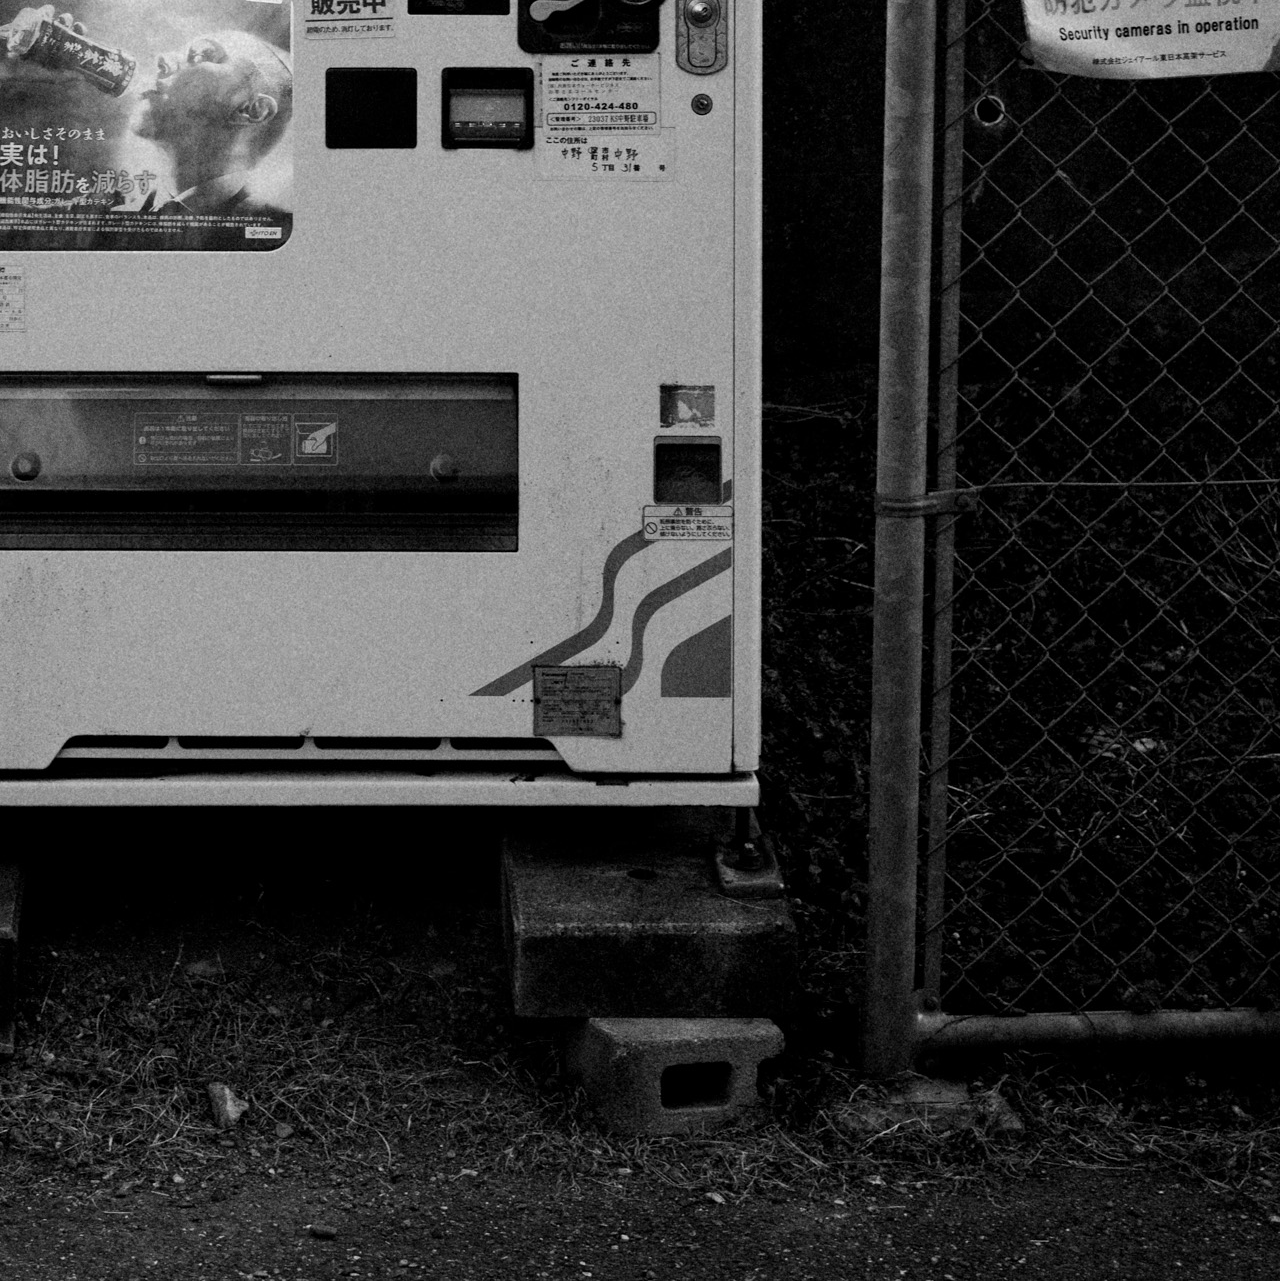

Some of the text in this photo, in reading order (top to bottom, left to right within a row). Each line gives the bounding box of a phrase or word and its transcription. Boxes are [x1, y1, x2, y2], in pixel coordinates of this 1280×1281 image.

[1059, 17, 1259, 41] Security cameras in operation
[570, 58, 632, 68] ご連絡先
[563, 102, 639, 111] 0120-424-480
[1, 127, 106, 141] おいしさそのまま
[546, 137, 588, 145] ここの住所は
[561, 146, 583, 160] 中野
[614, 148, 639, 161] 中野
